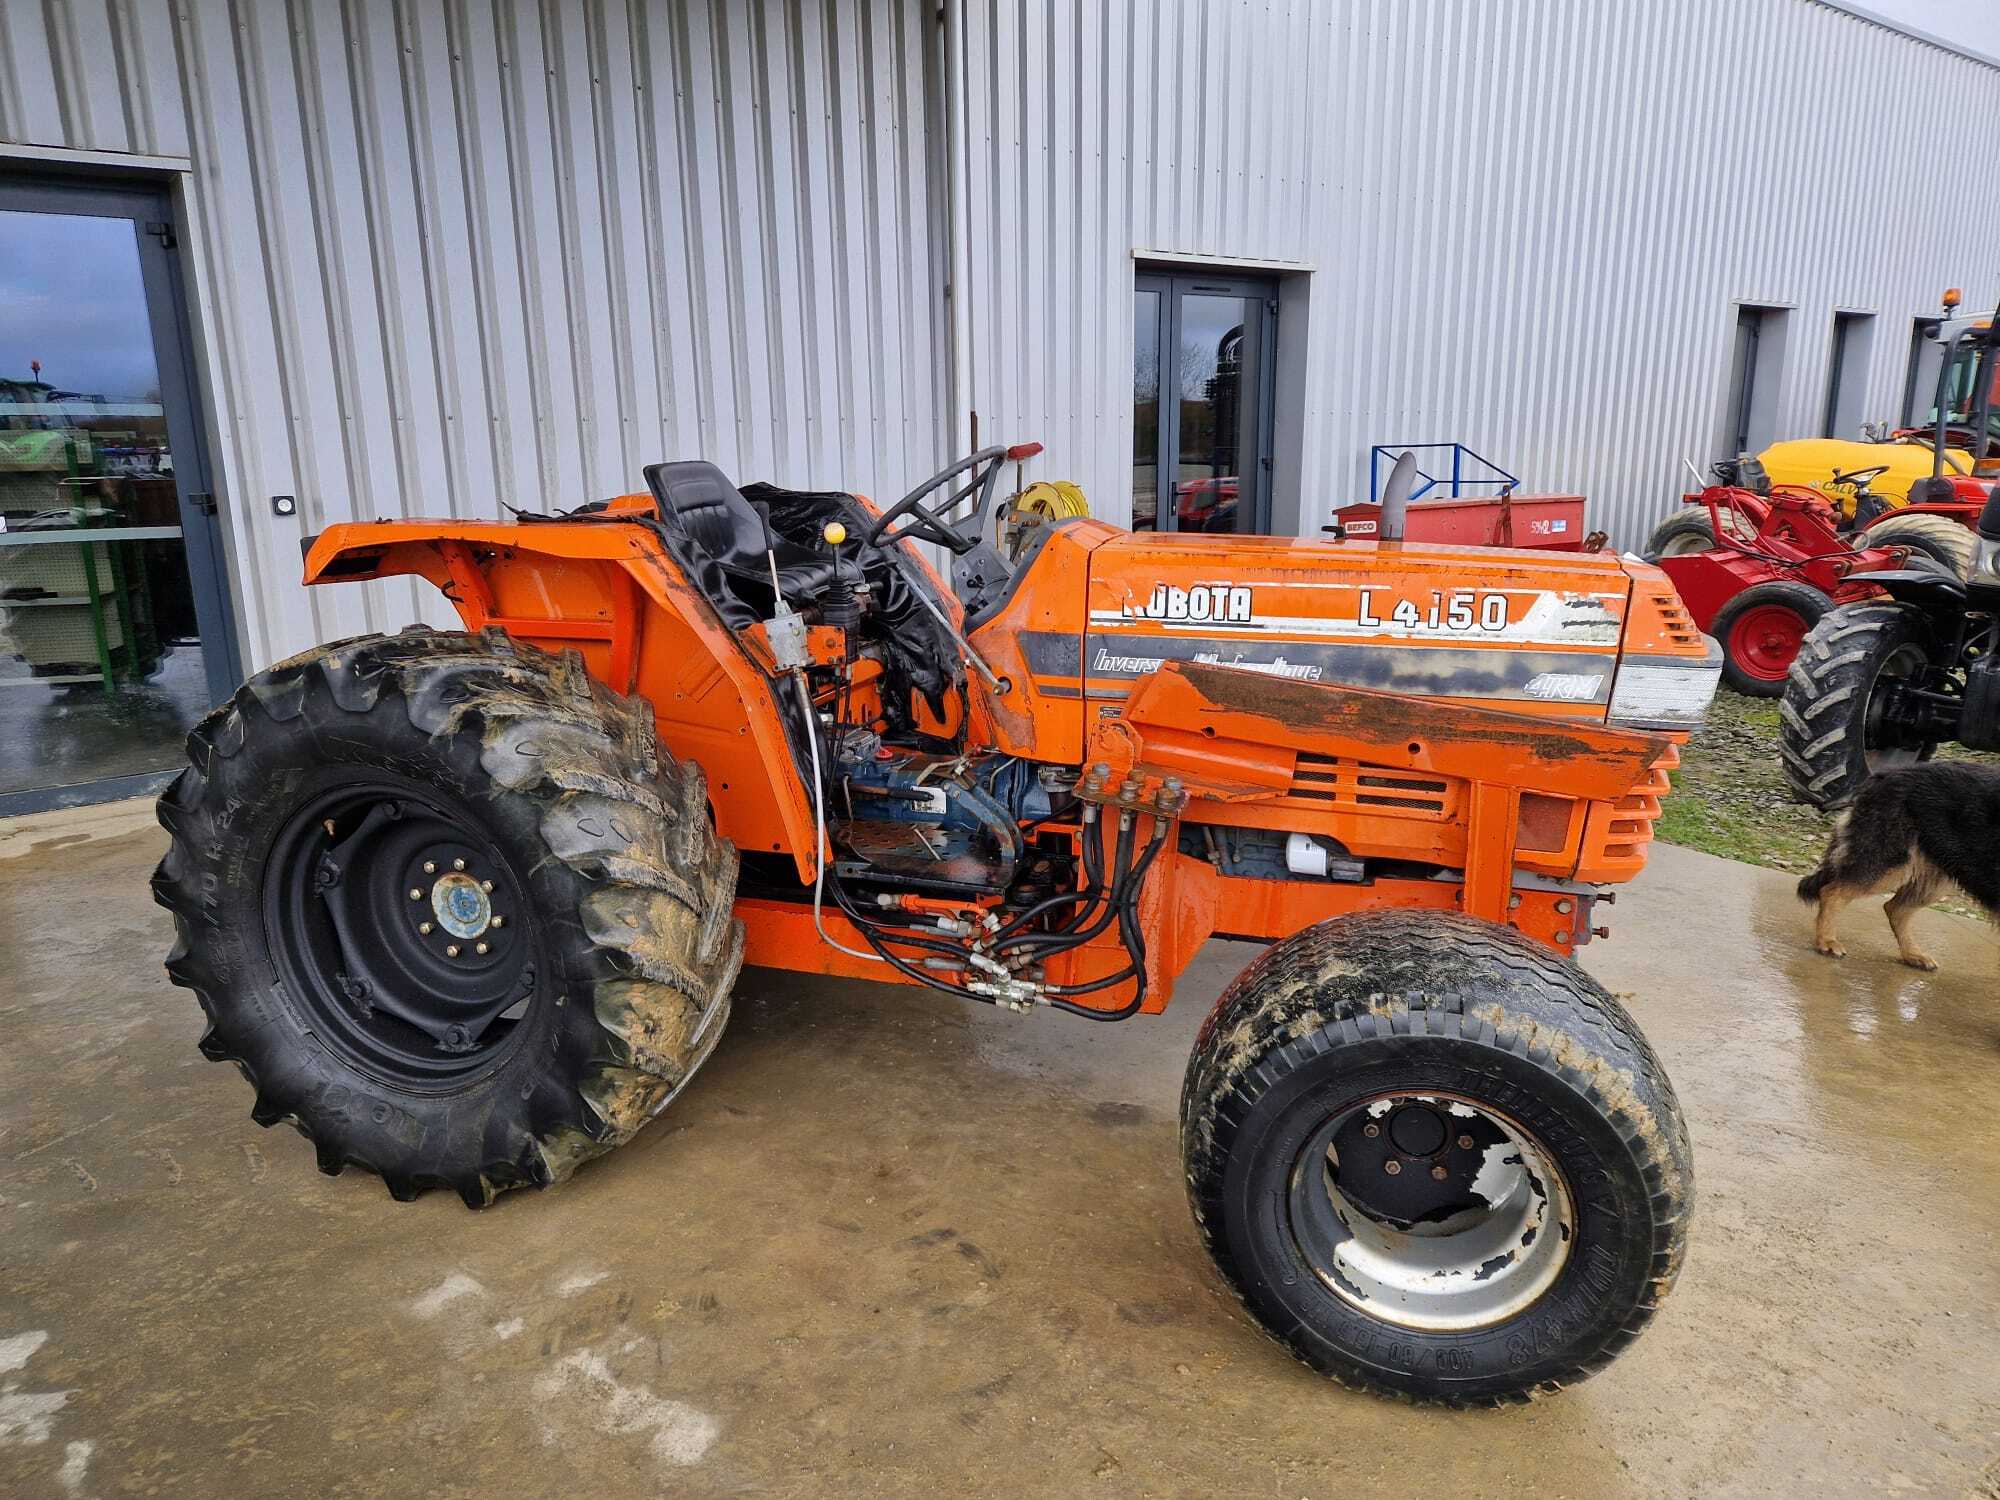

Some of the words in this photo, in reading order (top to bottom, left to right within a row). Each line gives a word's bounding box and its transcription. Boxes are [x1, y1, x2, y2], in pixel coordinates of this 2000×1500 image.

[1358, 589, 1382, 627] L
[1391, 592, 1509, 632] 4150
[1093, 648, 1166, 673] Invers
